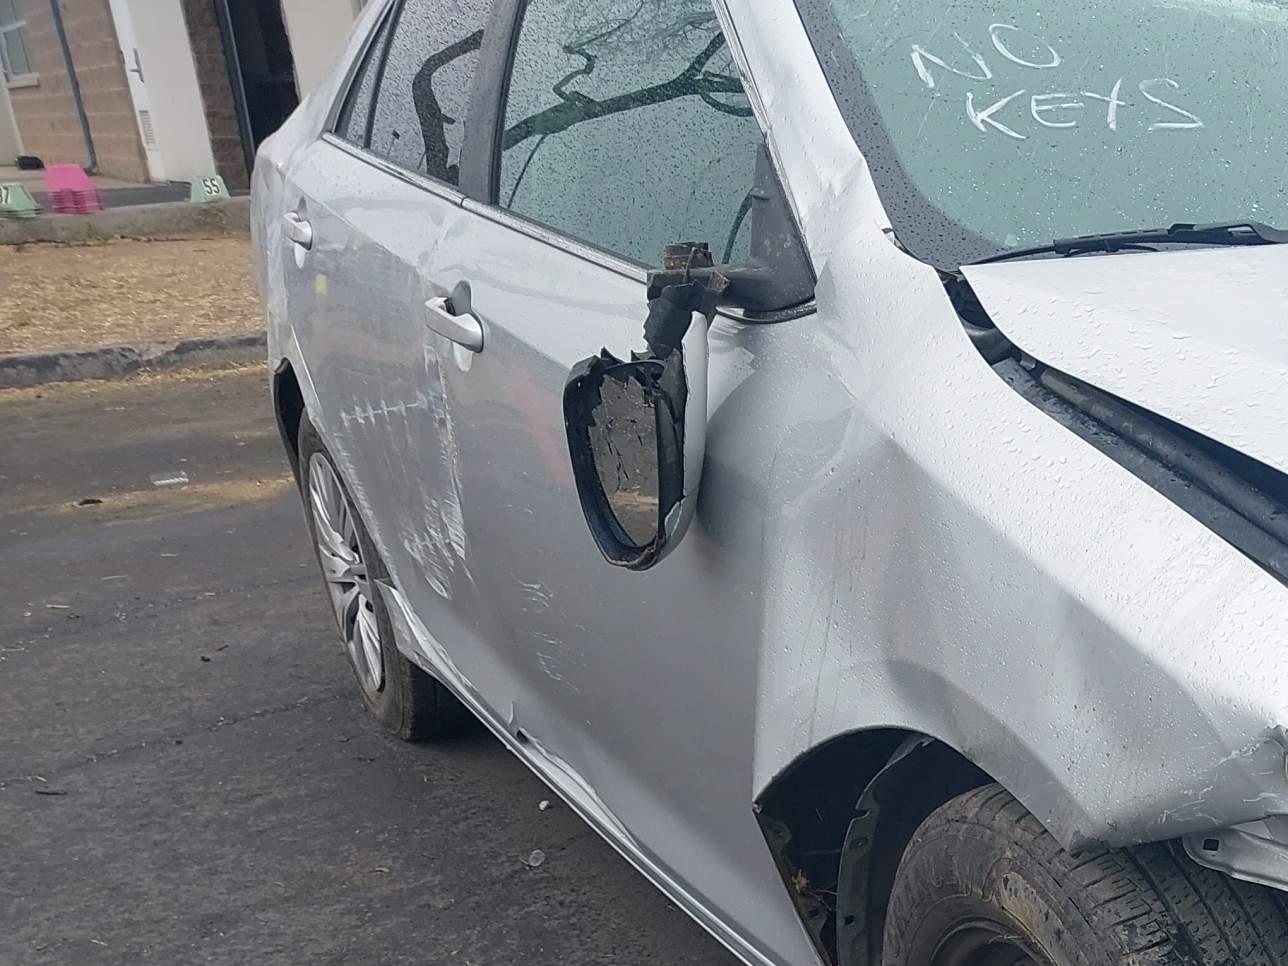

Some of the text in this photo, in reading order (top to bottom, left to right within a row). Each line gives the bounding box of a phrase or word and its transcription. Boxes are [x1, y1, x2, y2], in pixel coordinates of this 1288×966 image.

[911, 23, 1061, 88] NO
[966, 78, 1203, 139] KEYS
[203, 178, 220, 194] 55
